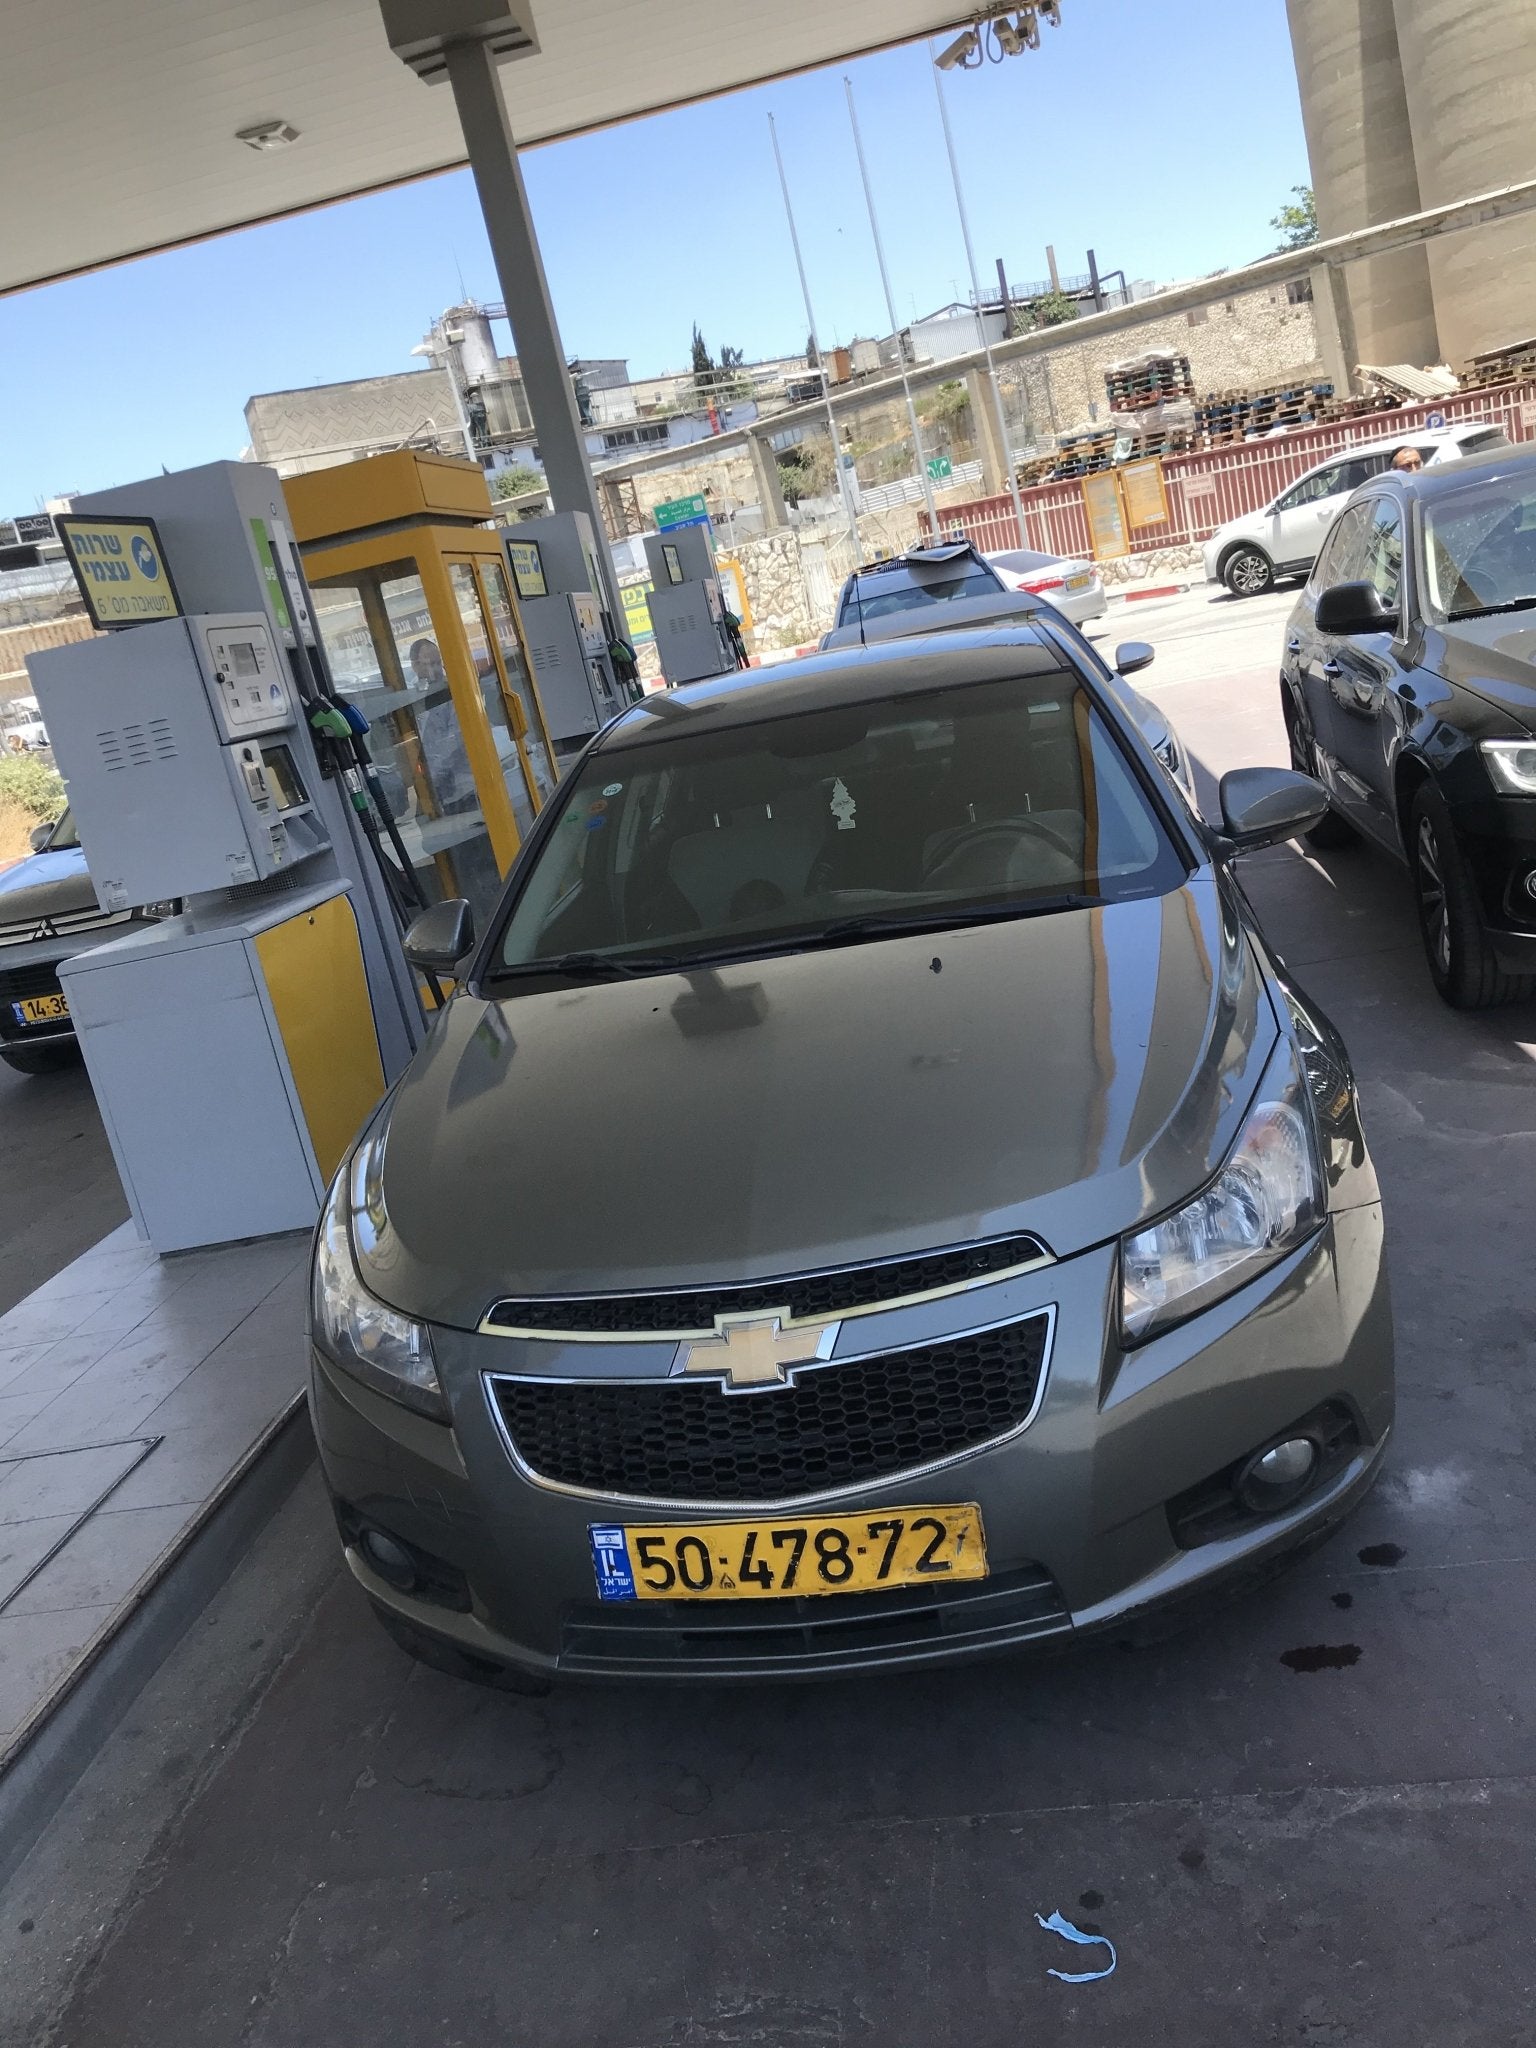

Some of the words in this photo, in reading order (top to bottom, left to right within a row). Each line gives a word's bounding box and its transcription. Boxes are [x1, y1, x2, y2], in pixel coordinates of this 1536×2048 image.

[70, 533, 123, 556] שרות
[82, 561, 132, 583] עצמי
[131, 595, 170, 613] משאבה
[600, 1577, 631, 1587] ישראל
